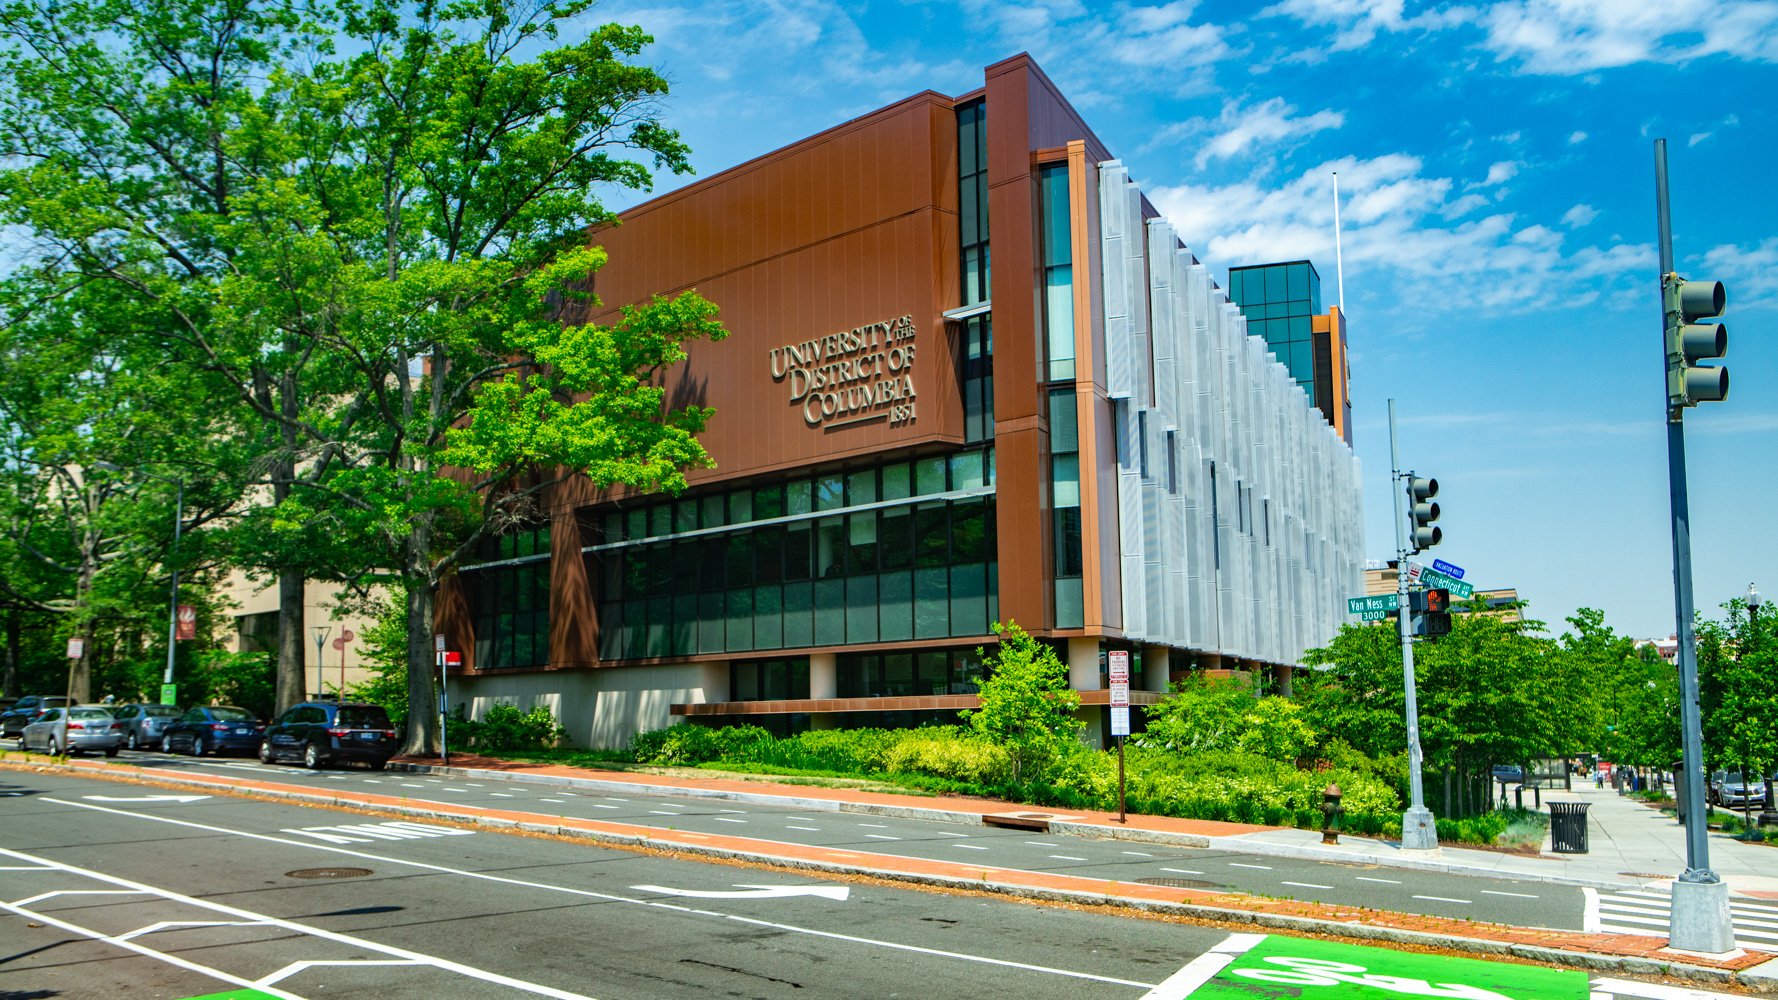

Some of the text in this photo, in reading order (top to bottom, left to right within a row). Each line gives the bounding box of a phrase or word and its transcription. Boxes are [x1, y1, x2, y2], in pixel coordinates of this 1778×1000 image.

[897, 315, 912, 327] OF
[894, 326, 915, 341] THE
[770, 318, 896, 379] UNIVERSITY
[789, 345, 915, 402] DISTRICT OF
[804, 374, 916, 424] COLUMBIA
[889, 402, 916, 424] 1851
[1422, 570, 1461, 594] Connecticut
[1350, 599, 1383, 612] Van Ness
[1363, 611, 1385, 620] 3000
[279, 821, 475, 844] ONLY
